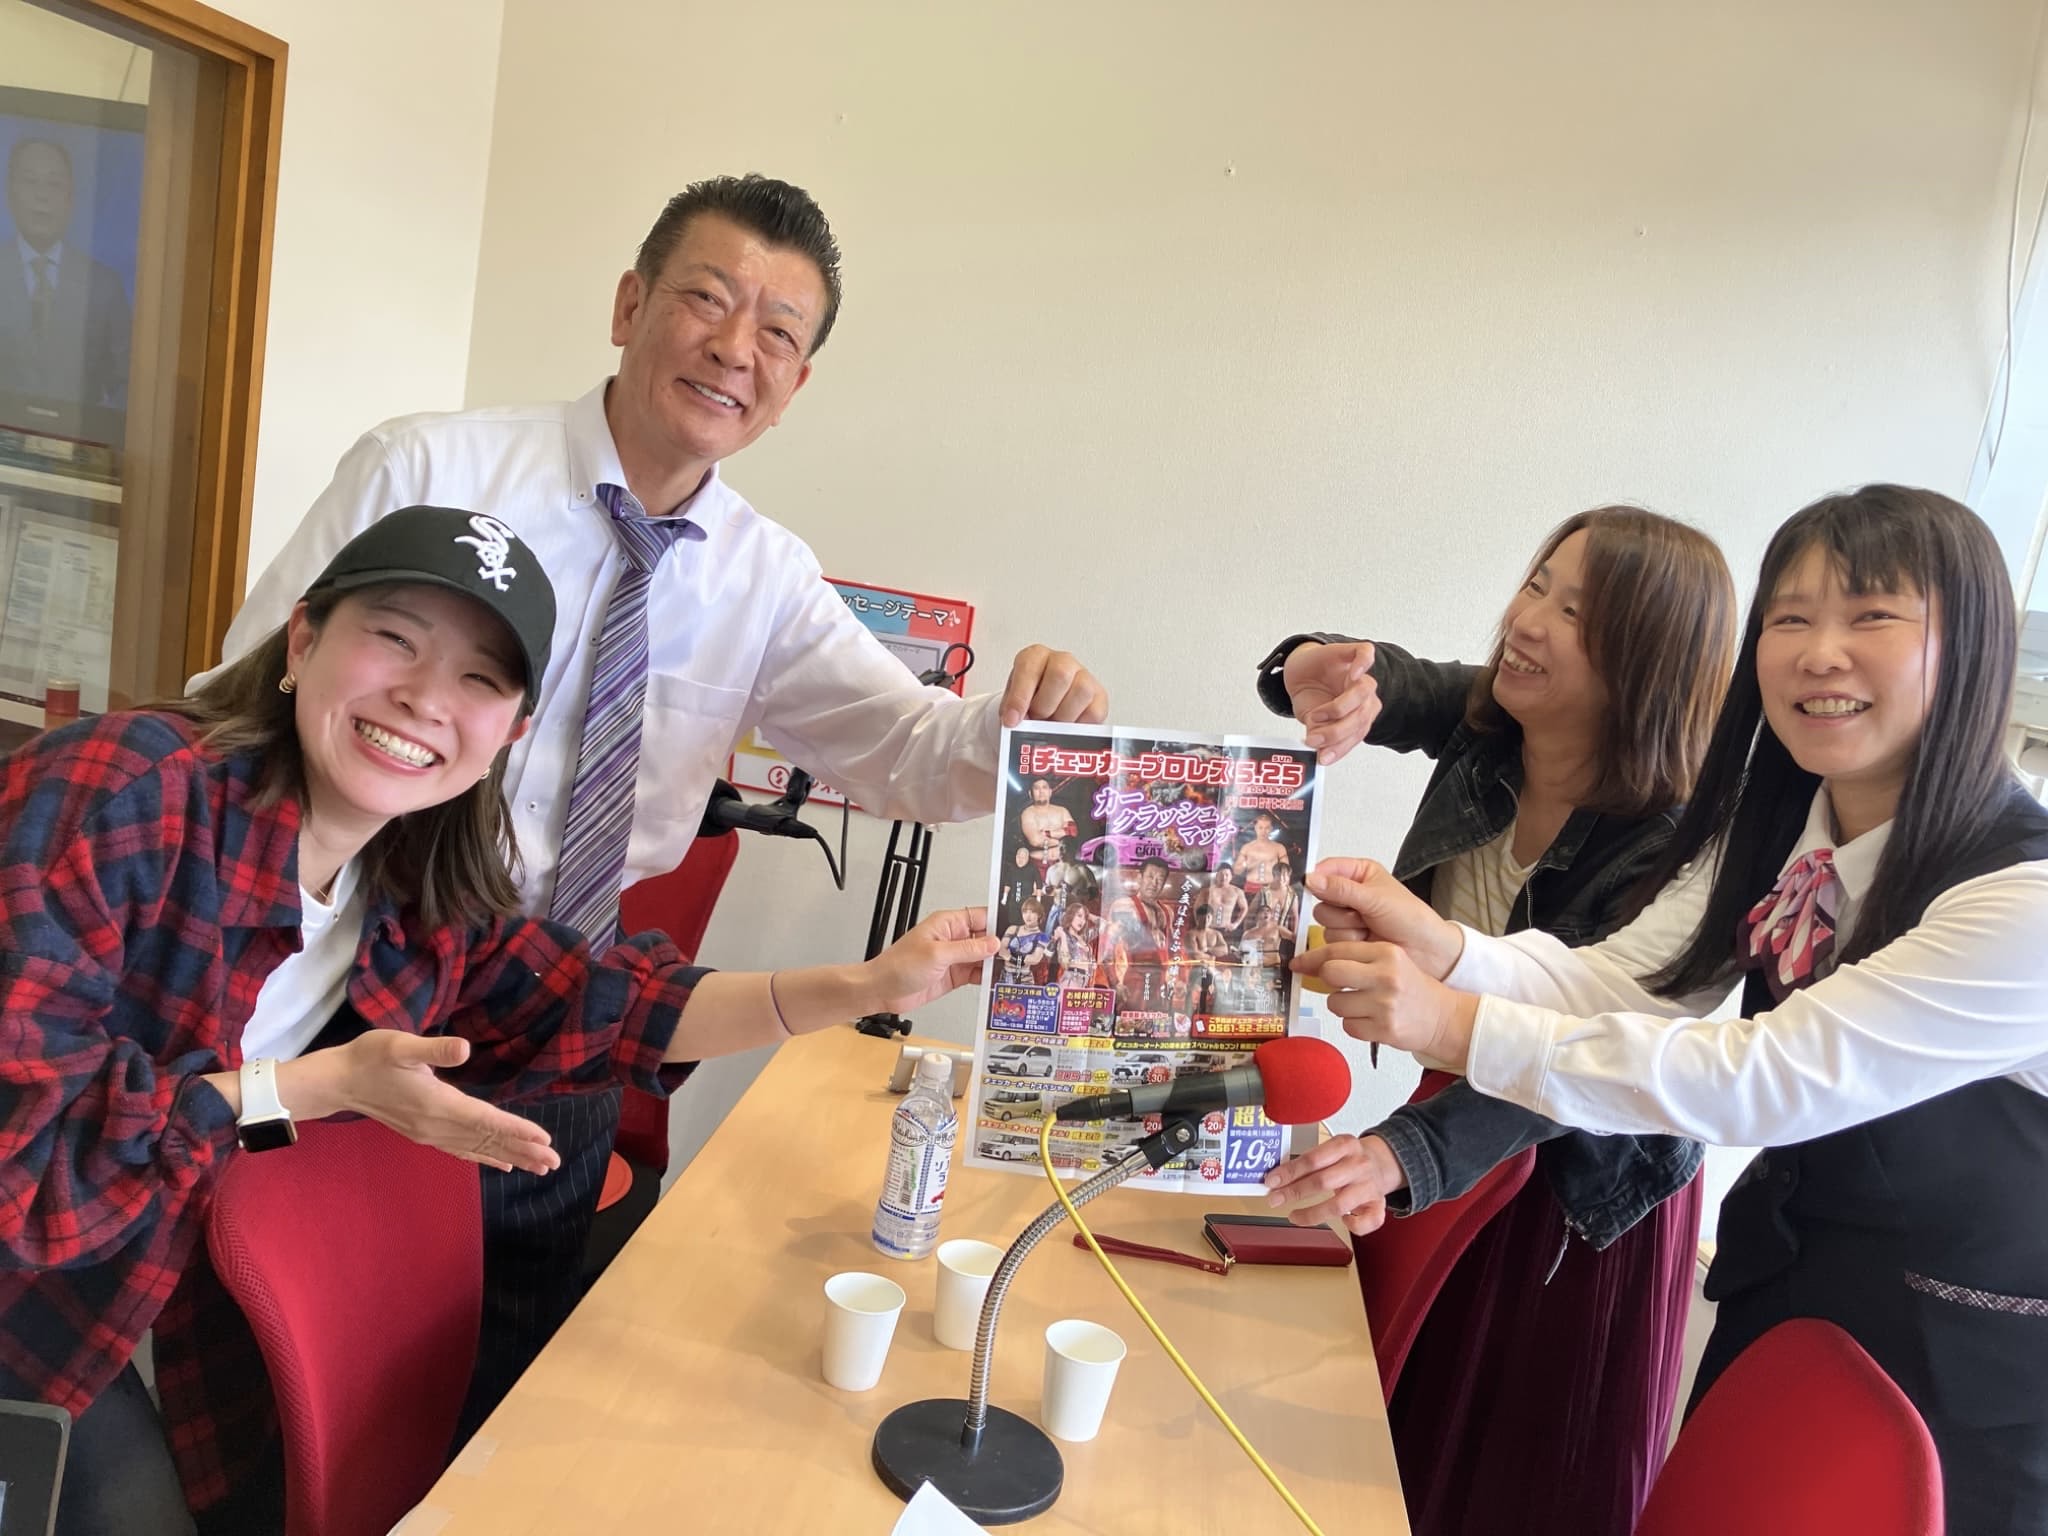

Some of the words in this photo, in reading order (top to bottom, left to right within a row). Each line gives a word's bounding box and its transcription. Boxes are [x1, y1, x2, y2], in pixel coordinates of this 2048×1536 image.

[1033, 747, 1229, 785] チェッカープロレス
[1235, 760, 1303, 786] 5.25
[1095, 787, 1144, 817] カー
[1113, 801, 1219, 833] クラッシュ
[1179, 820, 1237, 845] マッチ
